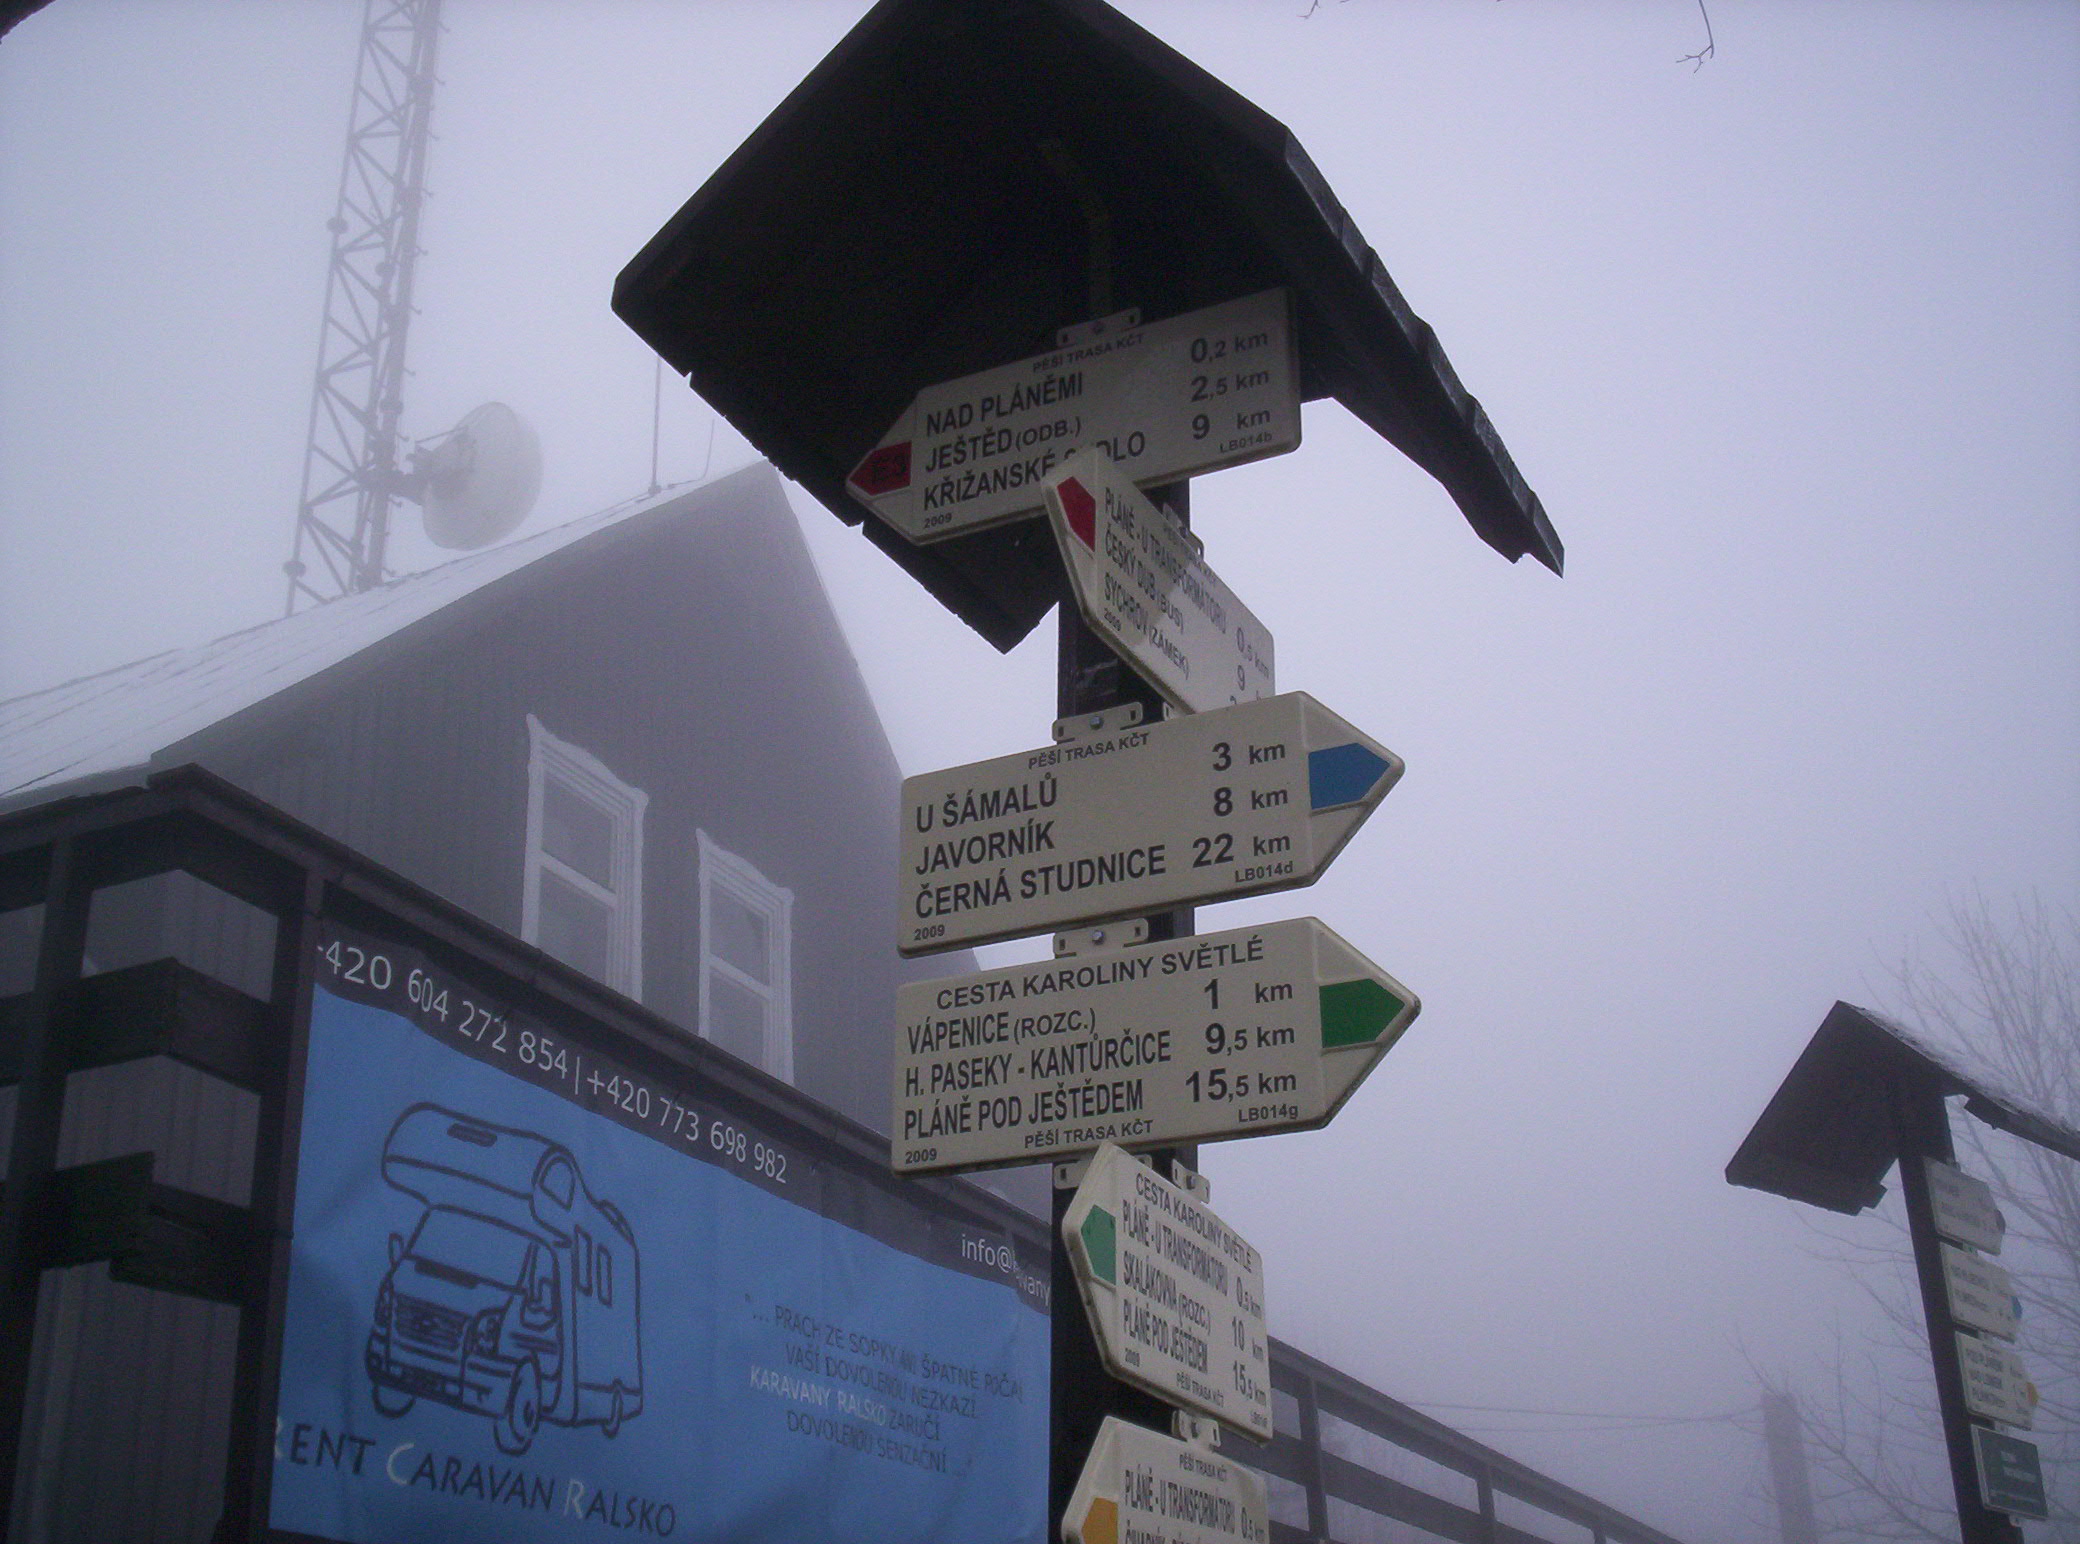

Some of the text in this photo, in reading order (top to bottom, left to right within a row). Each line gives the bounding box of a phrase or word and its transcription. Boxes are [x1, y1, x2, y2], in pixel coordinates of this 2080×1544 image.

[1067, 342, 1113, 364] TRASA
[1116, 332, 1143, 354] KČT
[1191, 330, 1268, 364] 0,2 km
[1191, 368, 1269, 402] 2,5 km
[926, 372, 1084, 437] NAD PLÁNĚMI
[1192, 407, 1270, 439] 9 km
[925, 416, 1081, 472] JEŠTĚD (ODB.)
[923, 512, 952, 529] 2009
[1237, 665, 1245, 690] 9
[1028, 733, 1149, 770] PĚŠÍ TRASA KČT
[1212, 741, 1286, 772] 3 km
[917, 774, 1057, 833] U ŠÁMALŮ
[1213, 787, 1288, 817] 8 km
[916, 819, 1055, 875] JAVORNÍK
[1192, 832, 1291, 868] 22 km
[916, 844, 1167, 920] ČERNÁ STUDNICE
[1234, 861, 1294, 885] LB014d
[914, 925, 945, 942] 2009
[936, 935, 1264, 1010] CESTA KAROLINY SVĚTLÉ
[1205, 979, 1293, 1010] 1 km
[907, 1008, 1096, 1055] VÁPENICE (ROZC.)
[1205, 1024, 1296, 1054] 9,5 km
[408, 968, 448, 1023] 604
[459, 1001, 507, 1053] 272
[659, 1098, 700, 1141] 773
[709, 1122, 747, 1162] 698
[753, 1142, 787, 1185] 982
[905, 1067, 925, 1097] H.
[931, 1054, 1012, 1095] PASEKY
[1031, 1030, 1171, 1079] KANTŮRČICE
[1185, 1069, 1297, 1104] 15,5 km
[904, 1078, 1144, 1140] PLÁNĚ POD JEŠTĚDEM
[1238, 1105, 1299, 1124] LB014g
[1025, 1119, 1153, 1148] PĚŠÍ TRASA KČT
[905, 1148, 937, 1164] 2009
[1122, 1199, 1149, 1247] PLÁNĚ
[1136, 1173, 1172, 1215] CESTA
[1174, 1198, 1223, 1247] KAROLINY
[825, 1325, 844, 1350] ZE
[849, 1332, 896, 1366] SOPKY
[1232, 1316, 1245, 1351] 10
[750, 1365, 831, 1407] KARAVANY
[837, 1391, 886, 1426] RALSKO
[386, 1442, 556, 1512] CARAVAN
[564, 1478, 677, 1538] RALSKO
